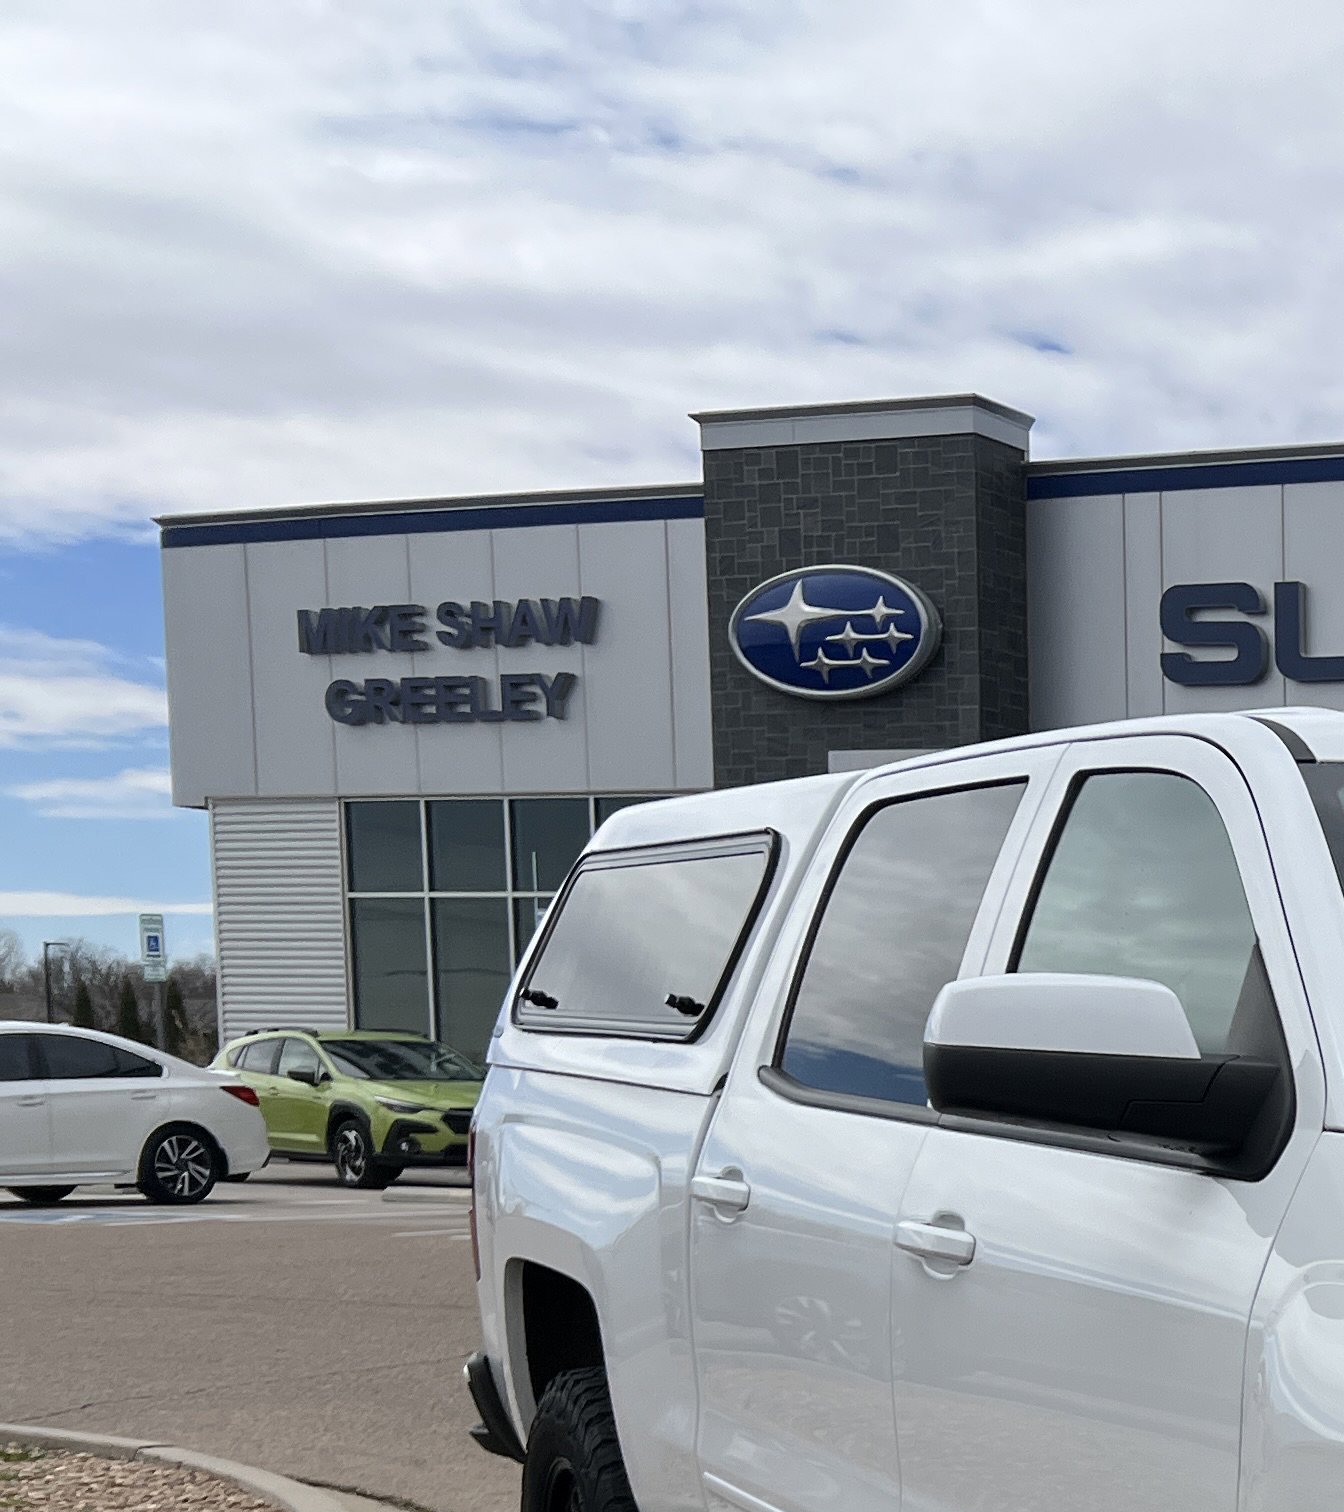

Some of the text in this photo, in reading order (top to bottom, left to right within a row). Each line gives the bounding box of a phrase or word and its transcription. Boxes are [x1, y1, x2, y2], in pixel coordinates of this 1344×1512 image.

[297, 596, 600, 655] MIKE SHAW
[325, 672, 578, 725] GREELEY
